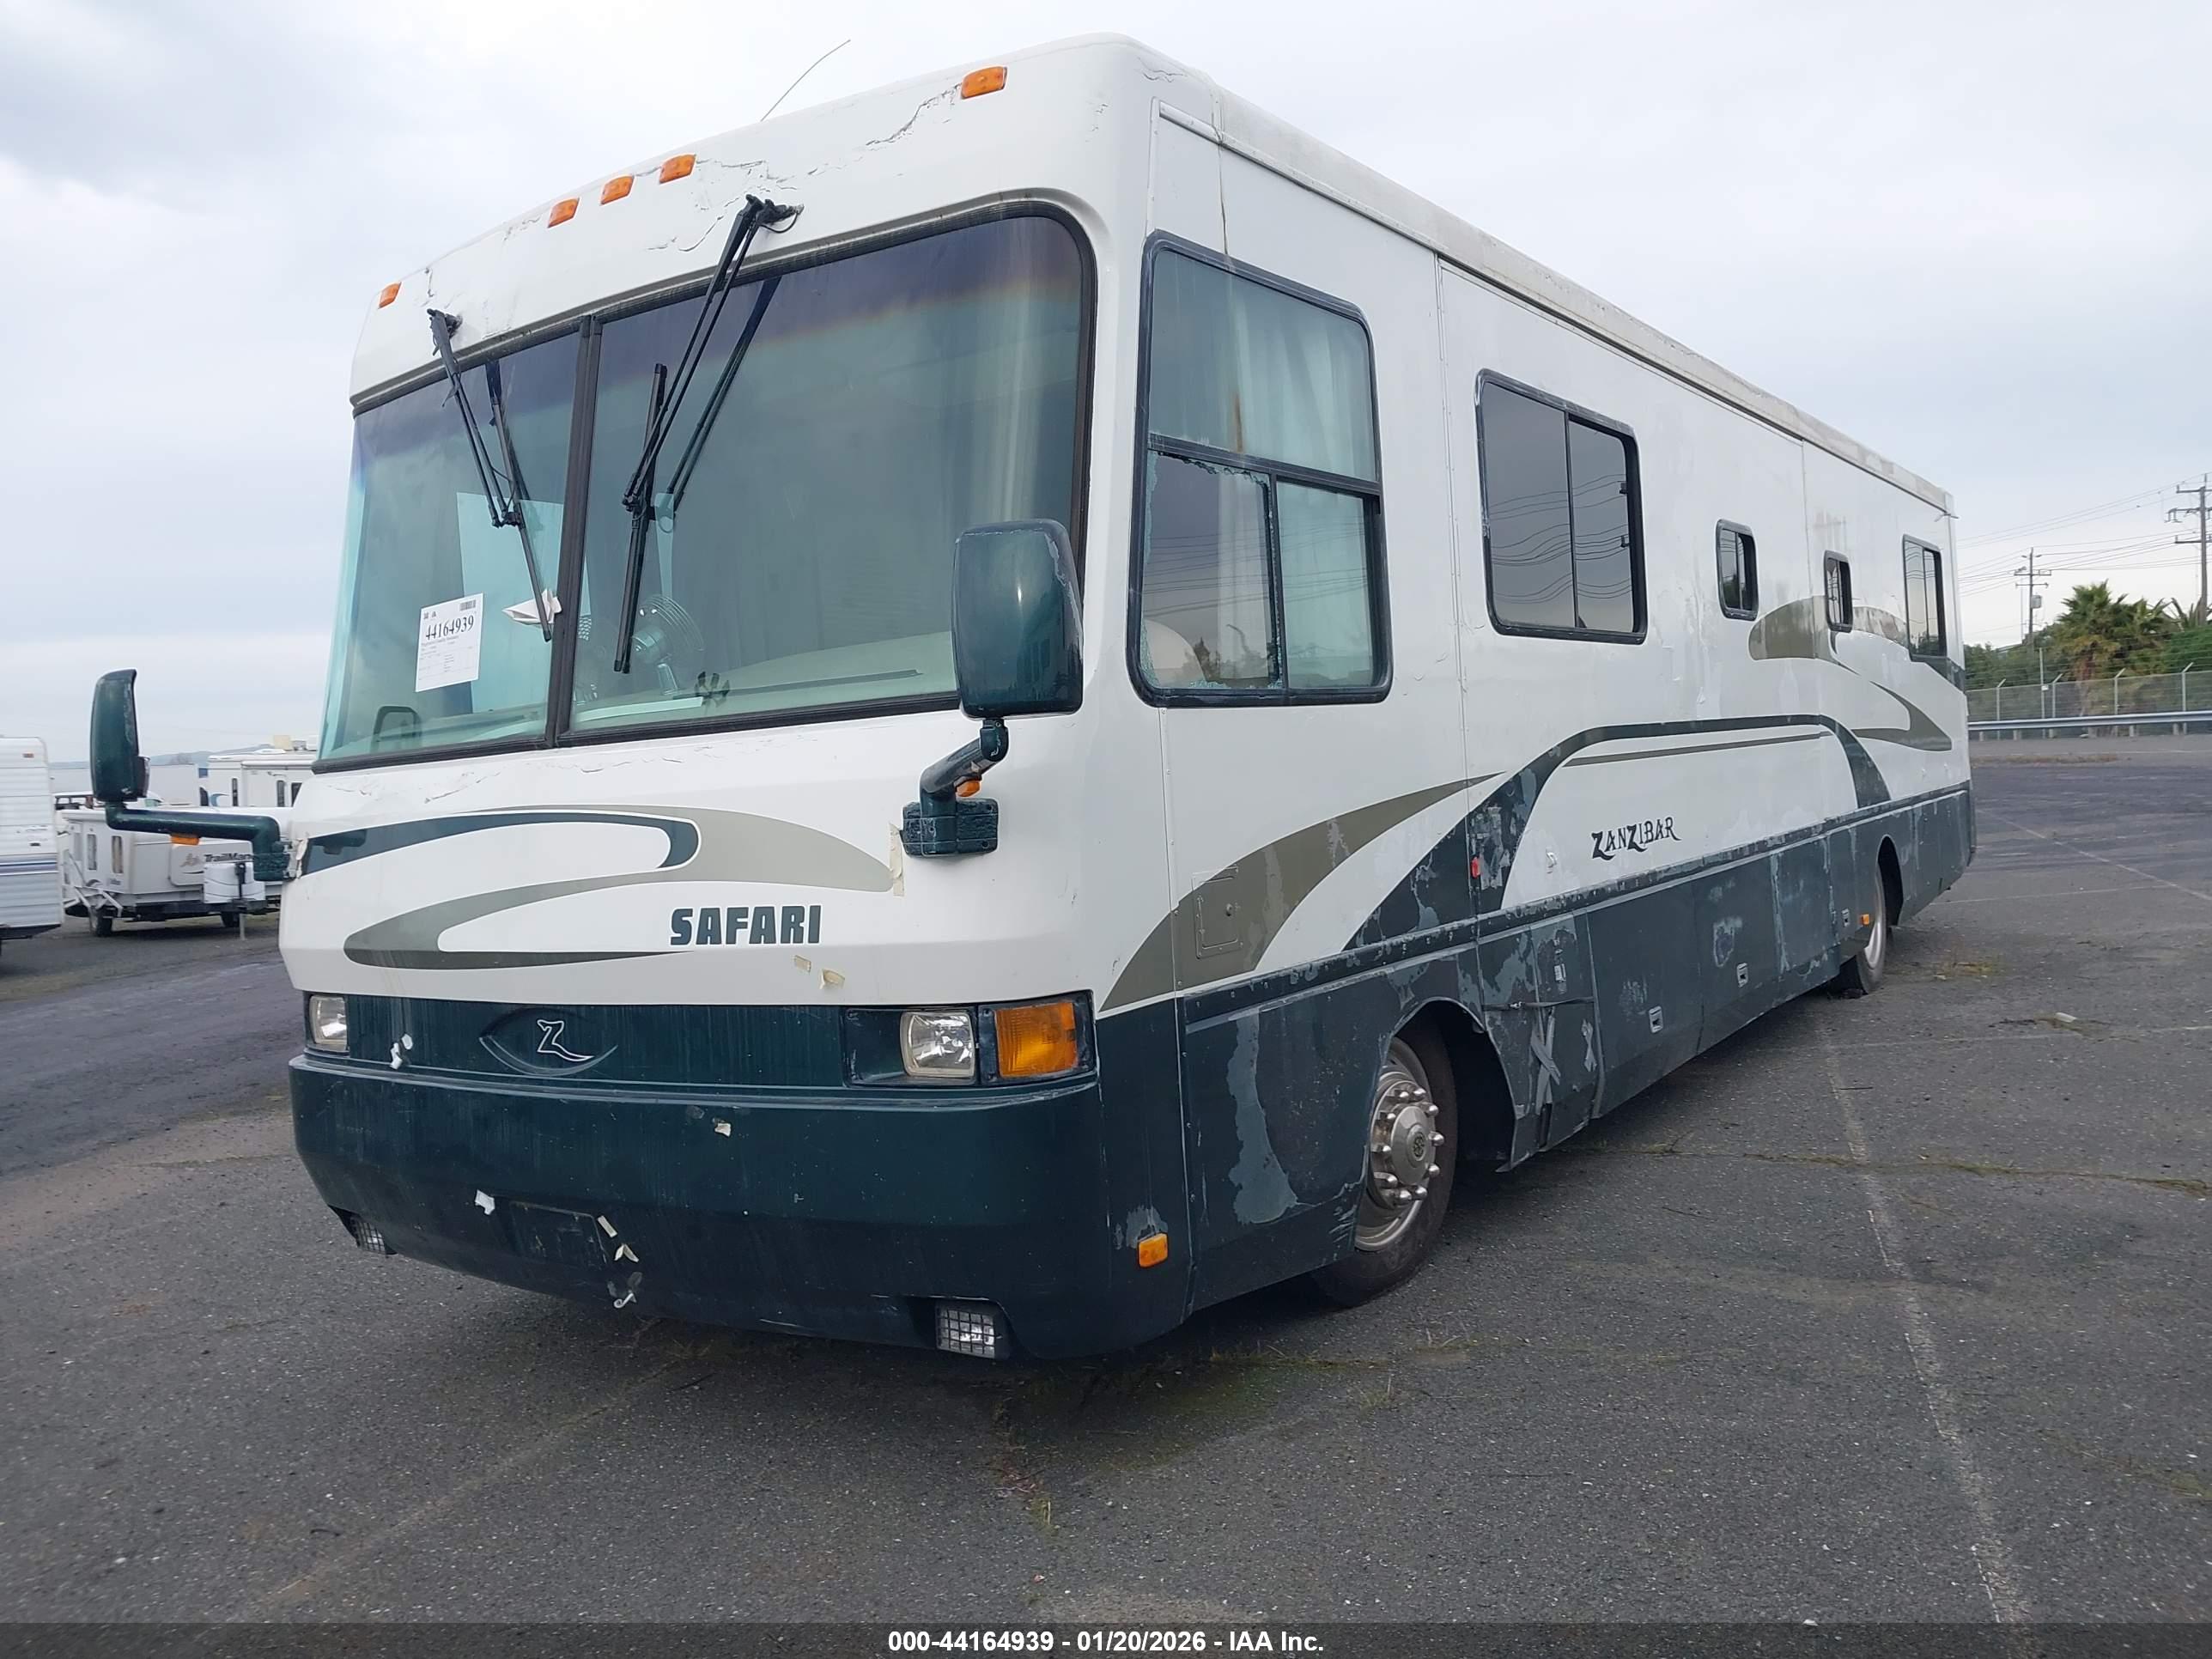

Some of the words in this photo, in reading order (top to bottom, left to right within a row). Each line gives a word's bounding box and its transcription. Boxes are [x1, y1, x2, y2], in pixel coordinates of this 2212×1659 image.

[425, 614, 475, 641] 44164939
[1590, 816, 1683, 861] ZANZIBAR
[204, 852, 254, 863] TrailMan
[670, 904, 822, 946] SAFARI
